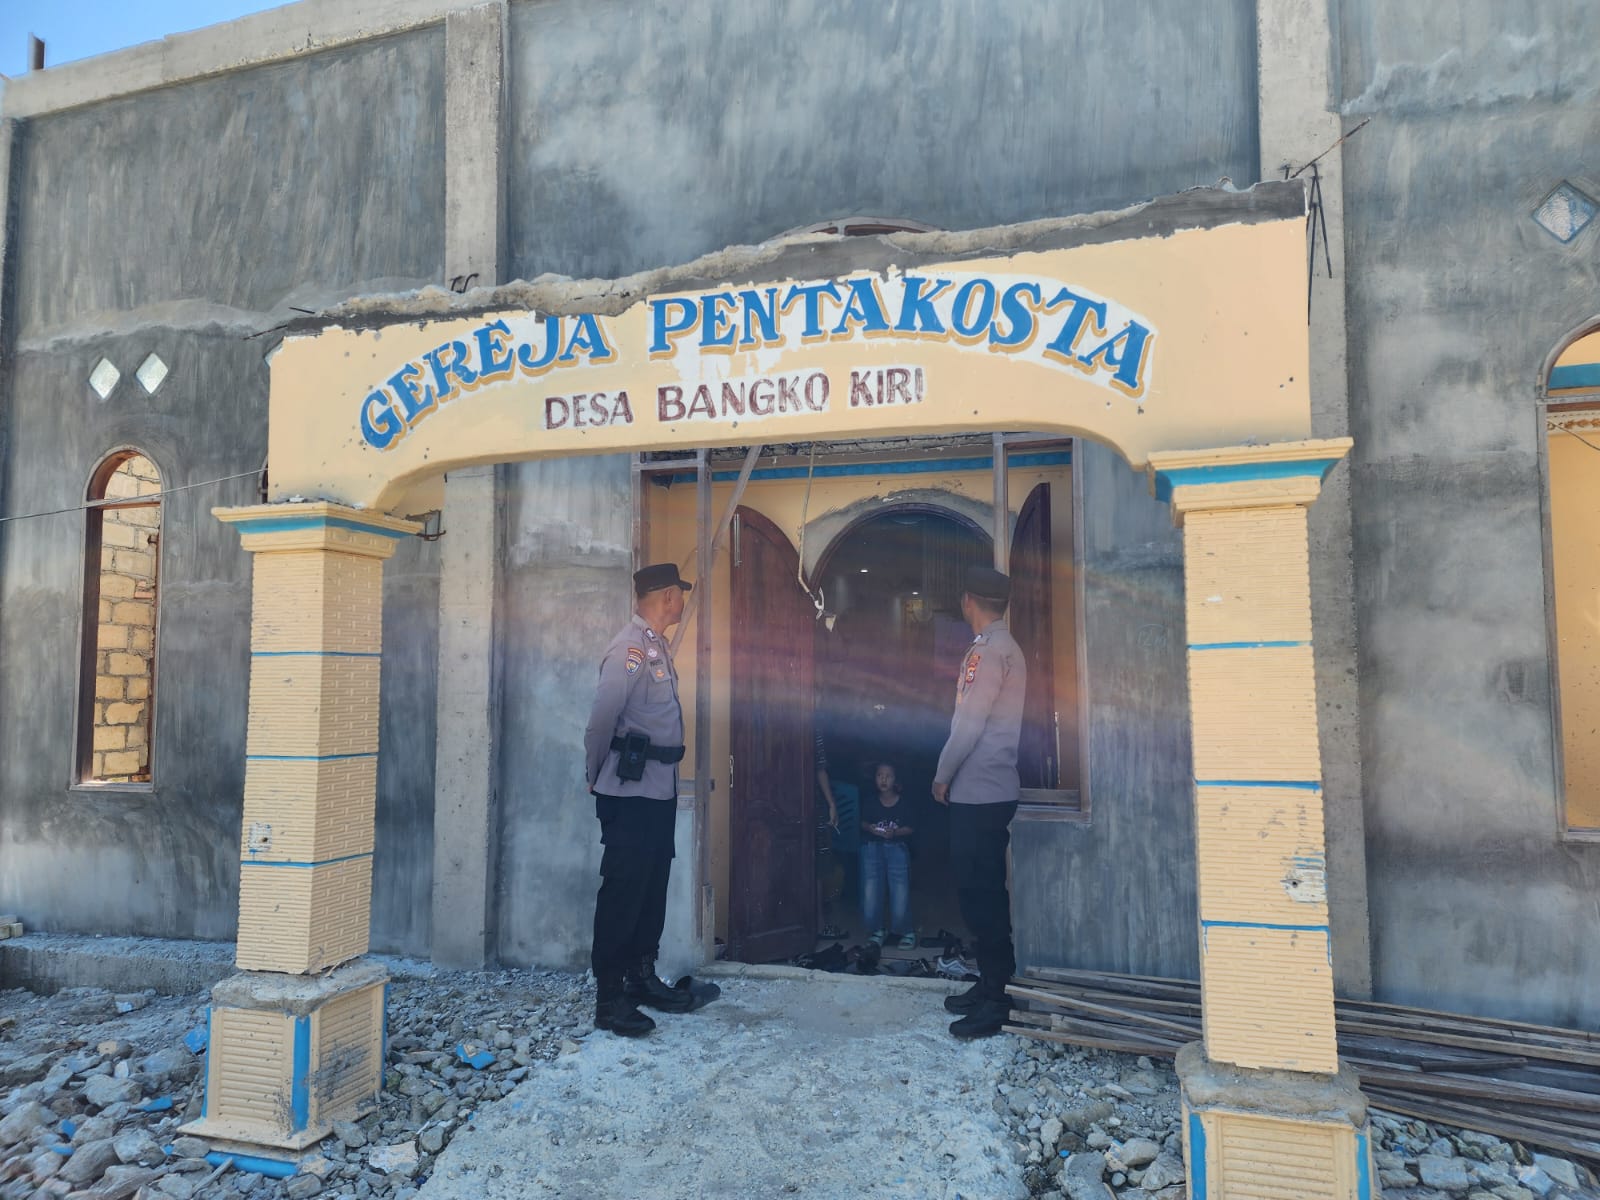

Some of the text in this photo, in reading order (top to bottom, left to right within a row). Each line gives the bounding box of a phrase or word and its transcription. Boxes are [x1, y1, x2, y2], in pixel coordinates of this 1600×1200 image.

[359, 276, 1154, 450] GEREJA PENTAKOSTA
[544, 367, 924, 431] DESA BANGKO KIRI
